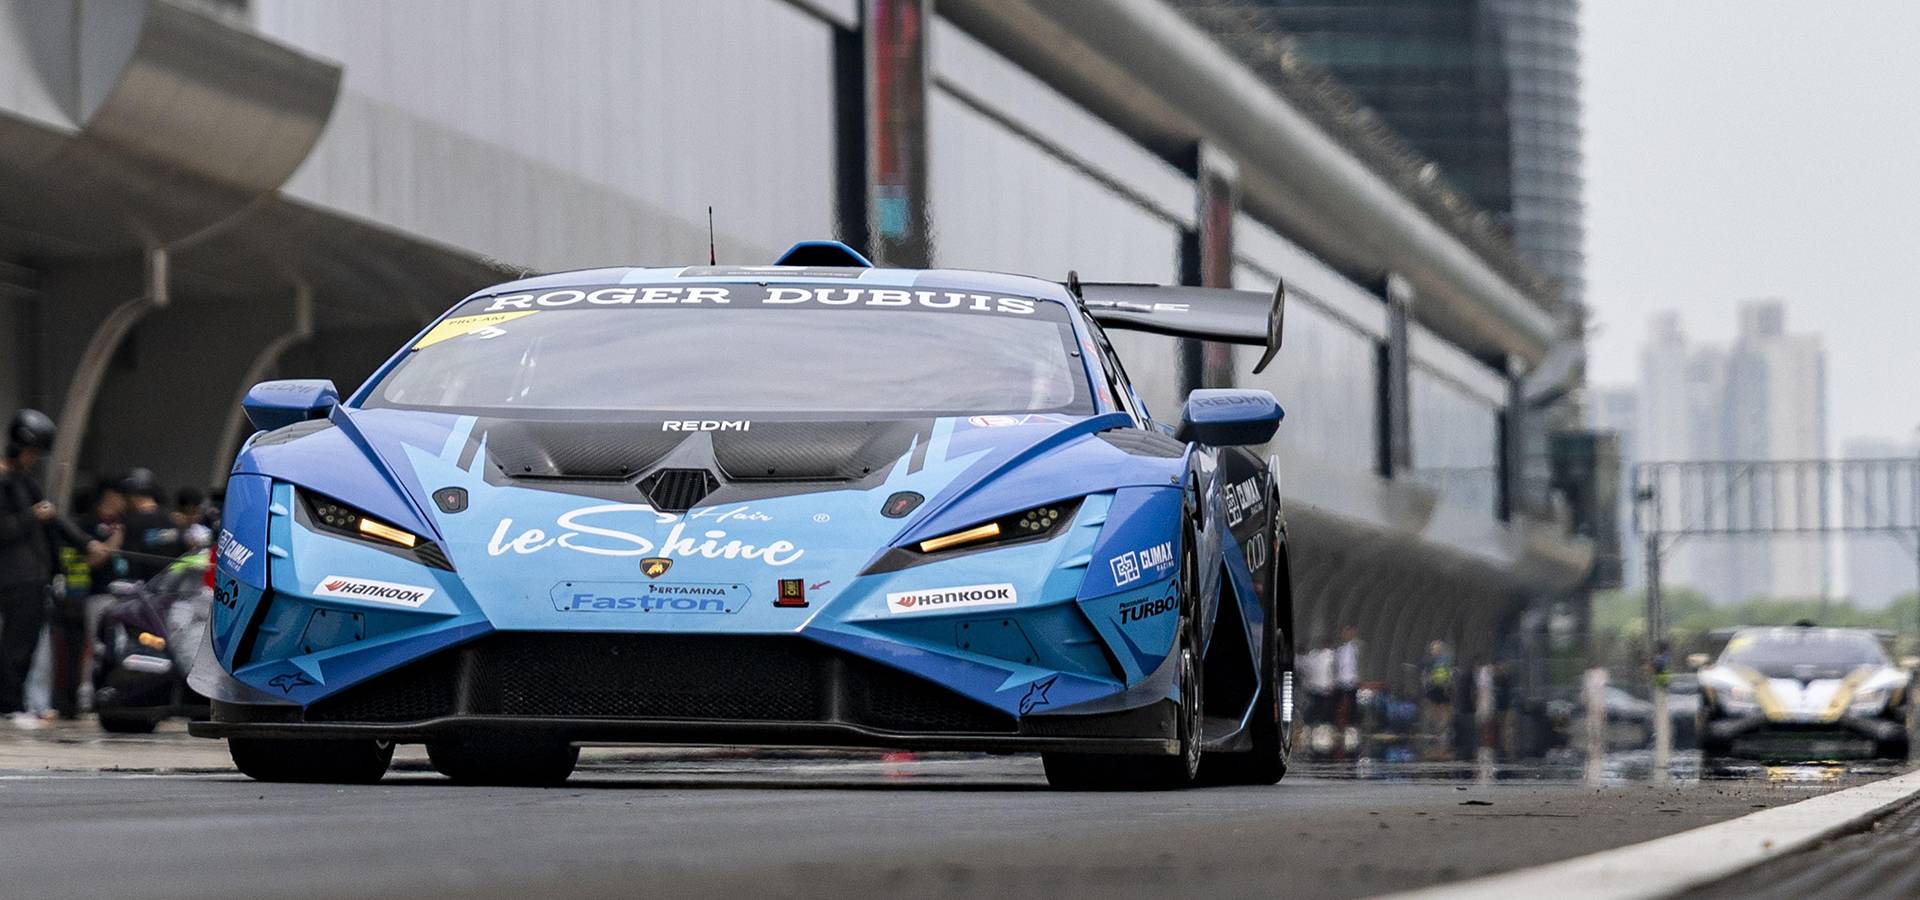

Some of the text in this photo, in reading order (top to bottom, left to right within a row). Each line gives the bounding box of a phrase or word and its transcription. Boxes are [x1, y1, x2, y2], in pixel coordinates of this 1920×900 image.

[484, 287, 1035, 315] ROGER DUBUIS
[662, 420, 750, 432] REDMI
[1235, 476, 1262, 511] CLIMAX
[690, 506, 773, 523] Hair
[224, 539, 254, 567] CLIMAX
[1140, 541, 1173, 569] CLIMAX
[571, 593, 725, 611] Fastron
[649, 584, 726, 596] PERTAMINA
[1120, 595, 1175, 624] TURBO
